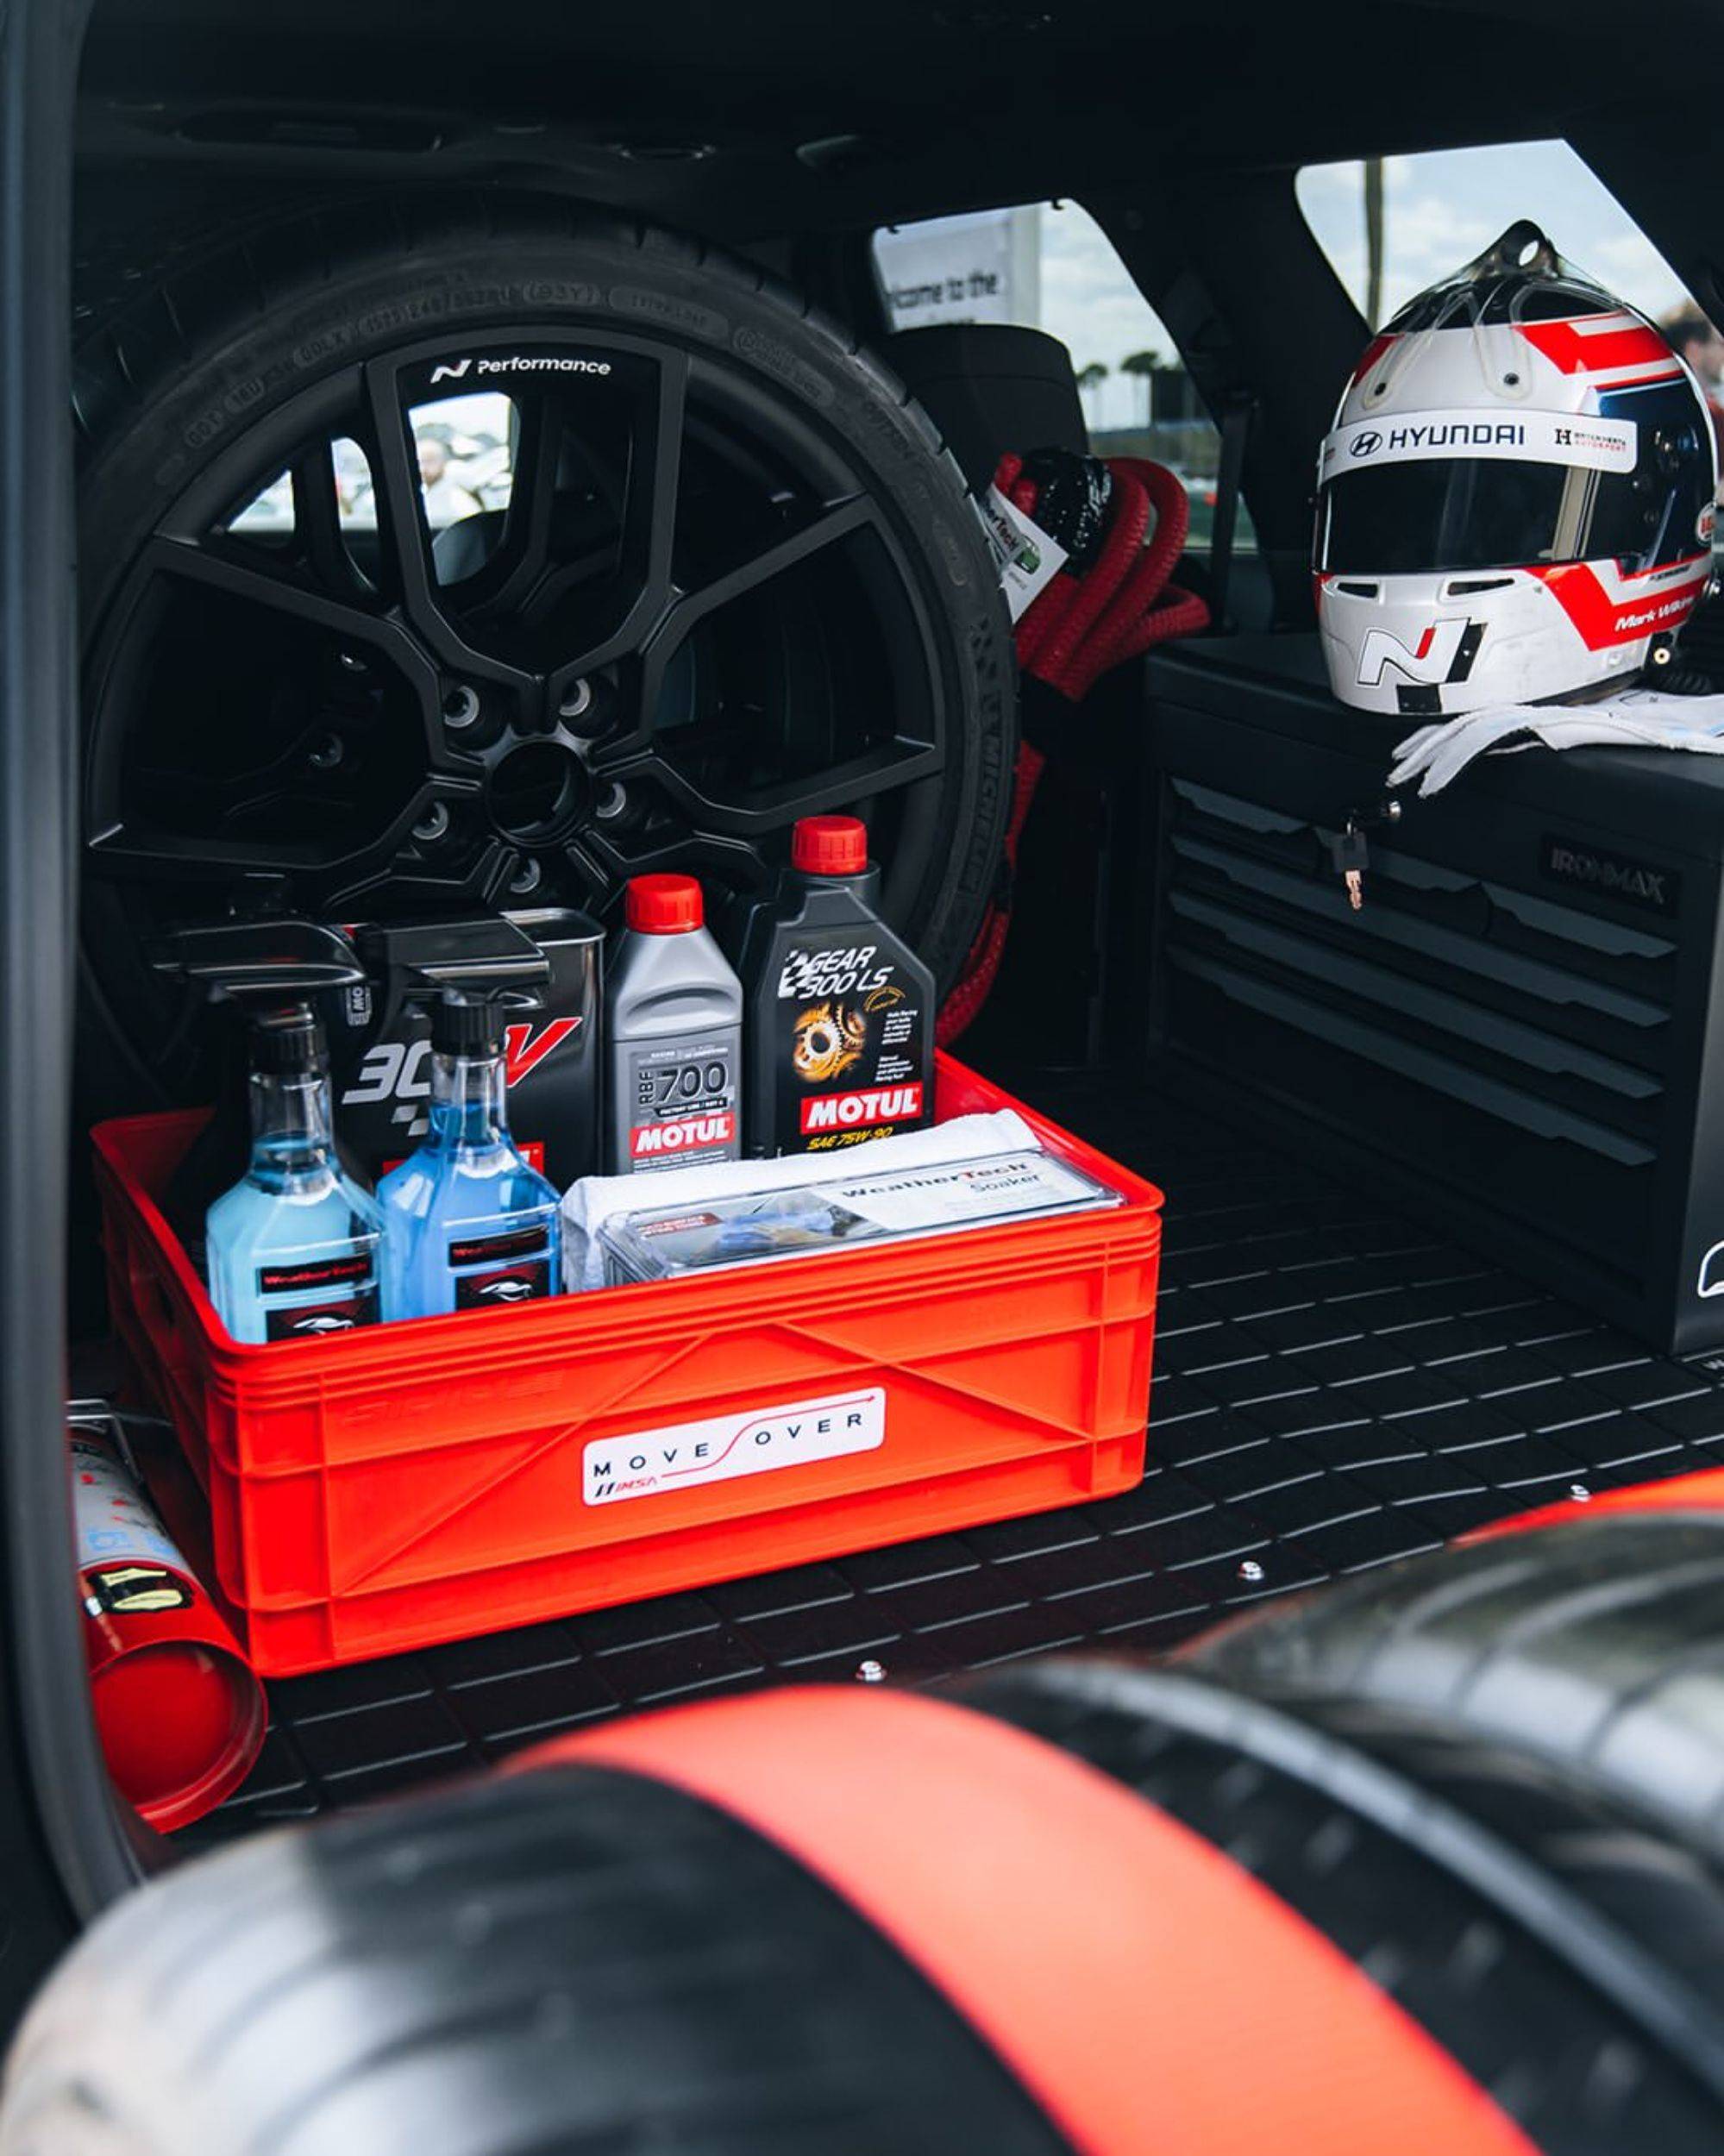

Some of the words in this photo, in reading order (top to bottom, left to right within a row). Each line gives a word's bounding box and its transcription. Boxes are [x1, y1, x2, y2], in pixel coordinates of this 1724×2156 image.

[477, 357, 611, 376] Performance
[1389, 425, 1525, 449] HYUNDAI
[1614, 609, 1655, 632] Mark
[1551, 847, 1665, 906] IRONMAX
[806, 945, 877, 975] GEAR
[798, 971, 857, 1000] 300
[856, 966, 894, 992] LS
[639, 1071, 654, 1105] RBF
[657, 1061, 729, 1104] 700
[807, 1087, 918, 1129] MOTUL
[636, 1117, 730, 1153] MOTUL
[806, 1135, 838, 1150] SAE
[837, 1125, 894, 1146] 75W-90
[843, 1162, 1029, 1198] WeatherTech
[969, 1173, 1040, 1193] Soaker
[593, 1443, 709, 1477] MOVE
[755, 1413, 862, 1445] OVER
